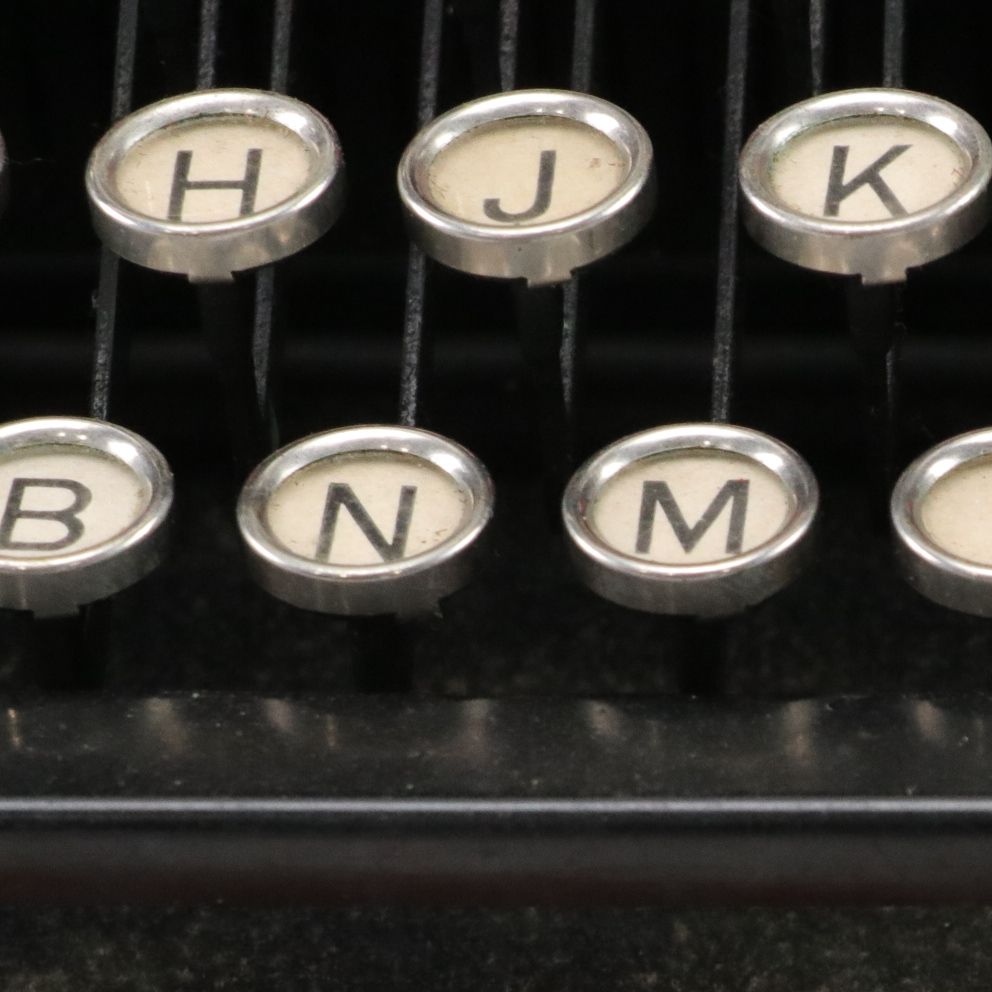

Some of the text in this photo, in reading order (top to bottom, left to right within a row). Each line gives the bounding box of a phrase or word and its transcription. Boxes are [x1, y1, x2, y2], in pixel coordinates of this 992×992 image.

[166, 148, 263, 221] H
[482, 149, 557, 223] J
[822, 143, 914, 219] K
[0, 477, 93, 551] B
[314, 481, 418, 562] N
[633, 479, 751, 555] M
